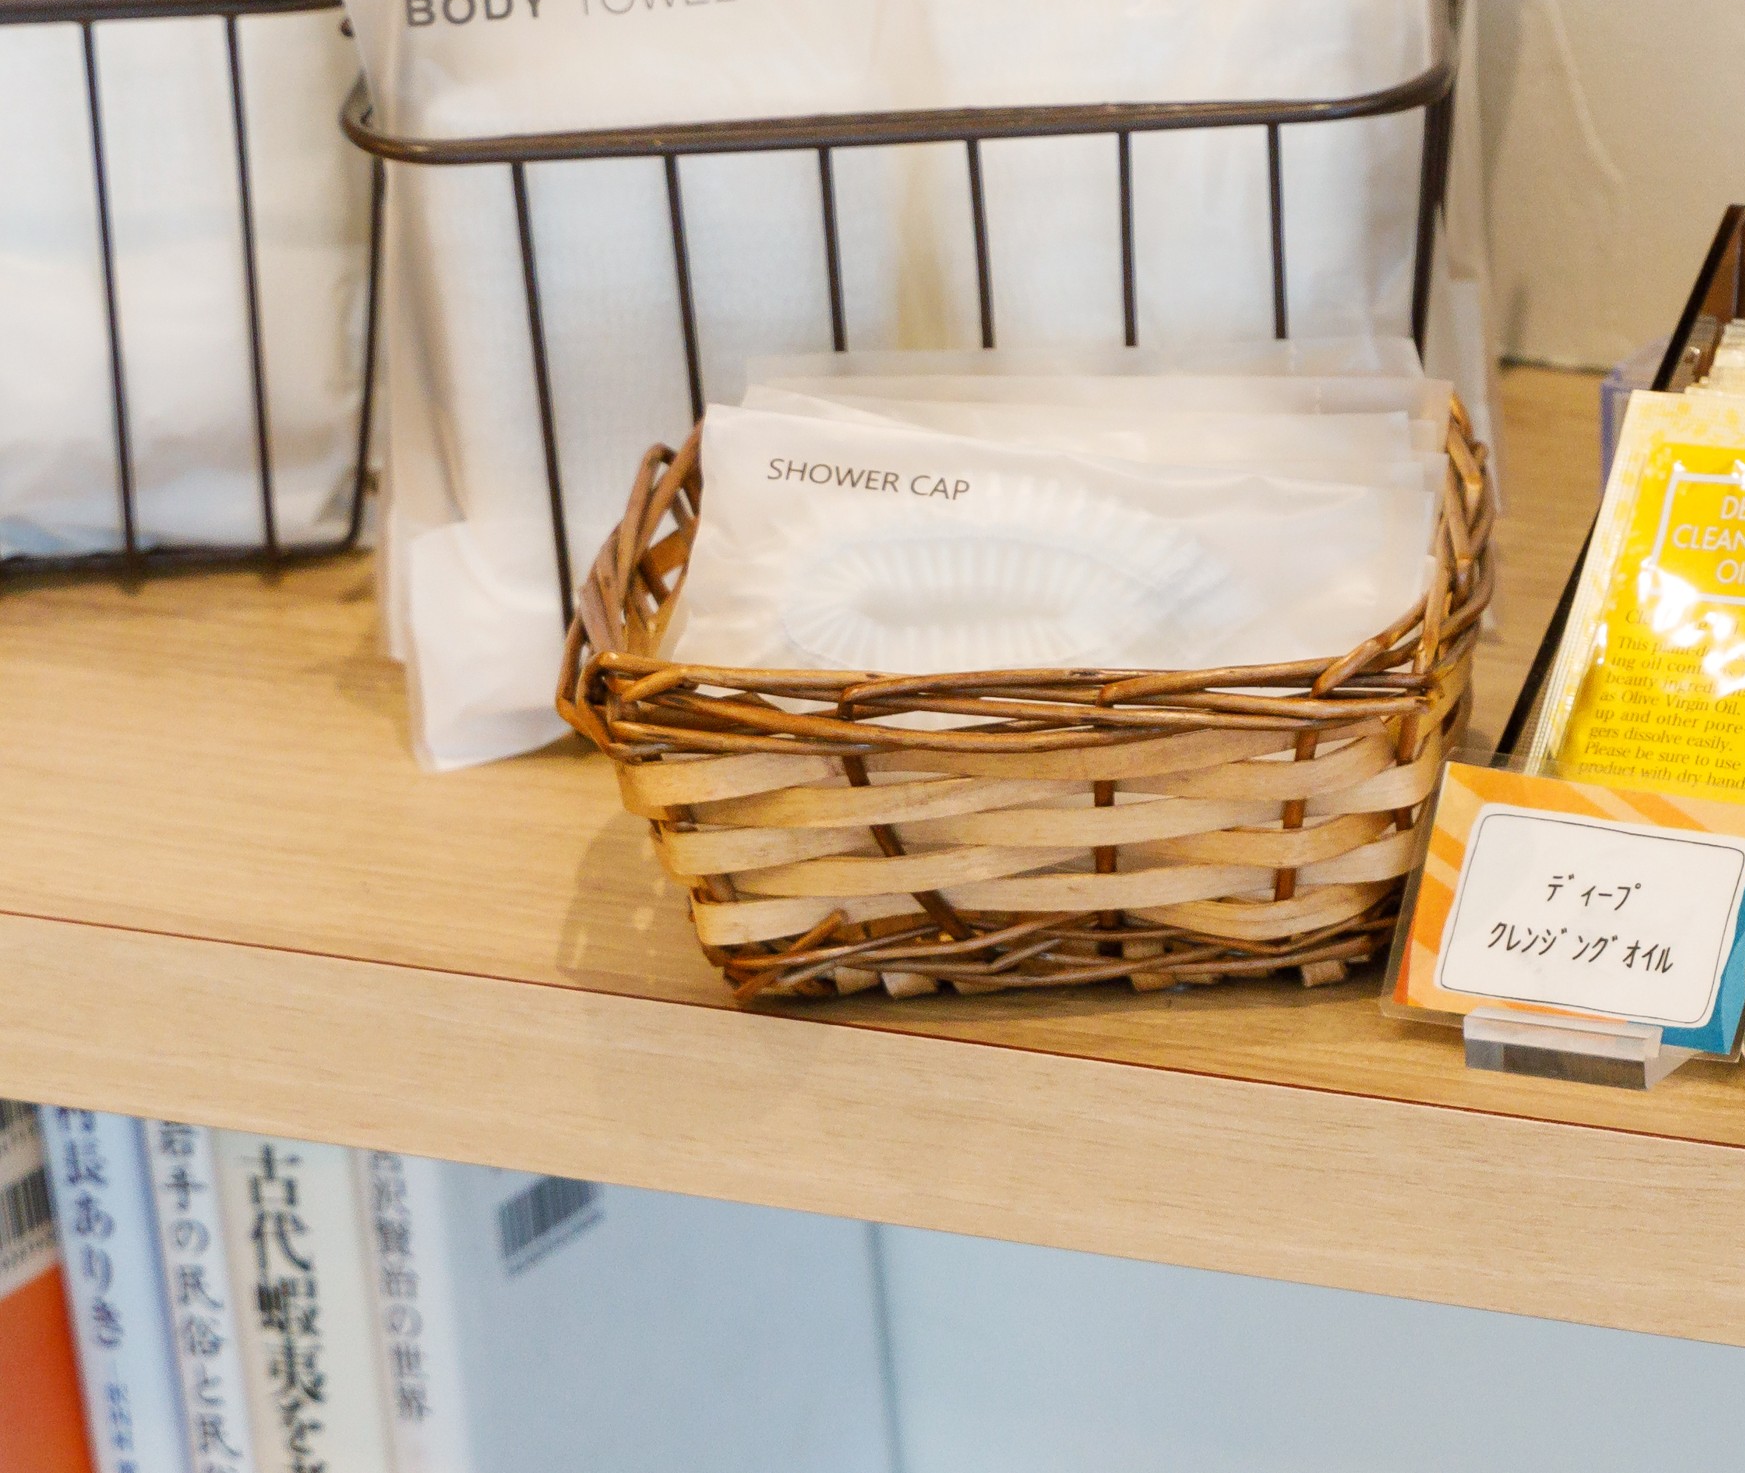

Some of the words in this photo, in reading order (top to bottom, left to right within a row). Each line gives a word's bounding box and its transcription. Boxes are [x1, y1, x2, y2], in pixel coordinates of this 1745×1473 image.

[766, 456, 901, 494] SHOWER
[910, 473, 971, 502] CAP
[1595, 708, 1614, 721] up
[1621, 709, 1651, 723] and
[1656, 714, 1699, 728] other
[1600, 690, 1614, 701] as
[1621, 690, 1659, 706] Olive
[1665, 694, 1709, 713] Virgin
[1714, 700, 1741, 716] Oil.
[1546, 872, 1643, 913] ディープ
[1487, 922, 1675, 975] クレンジングオイル
[242, 1142, 328, 1473] 古代蝦夷を
